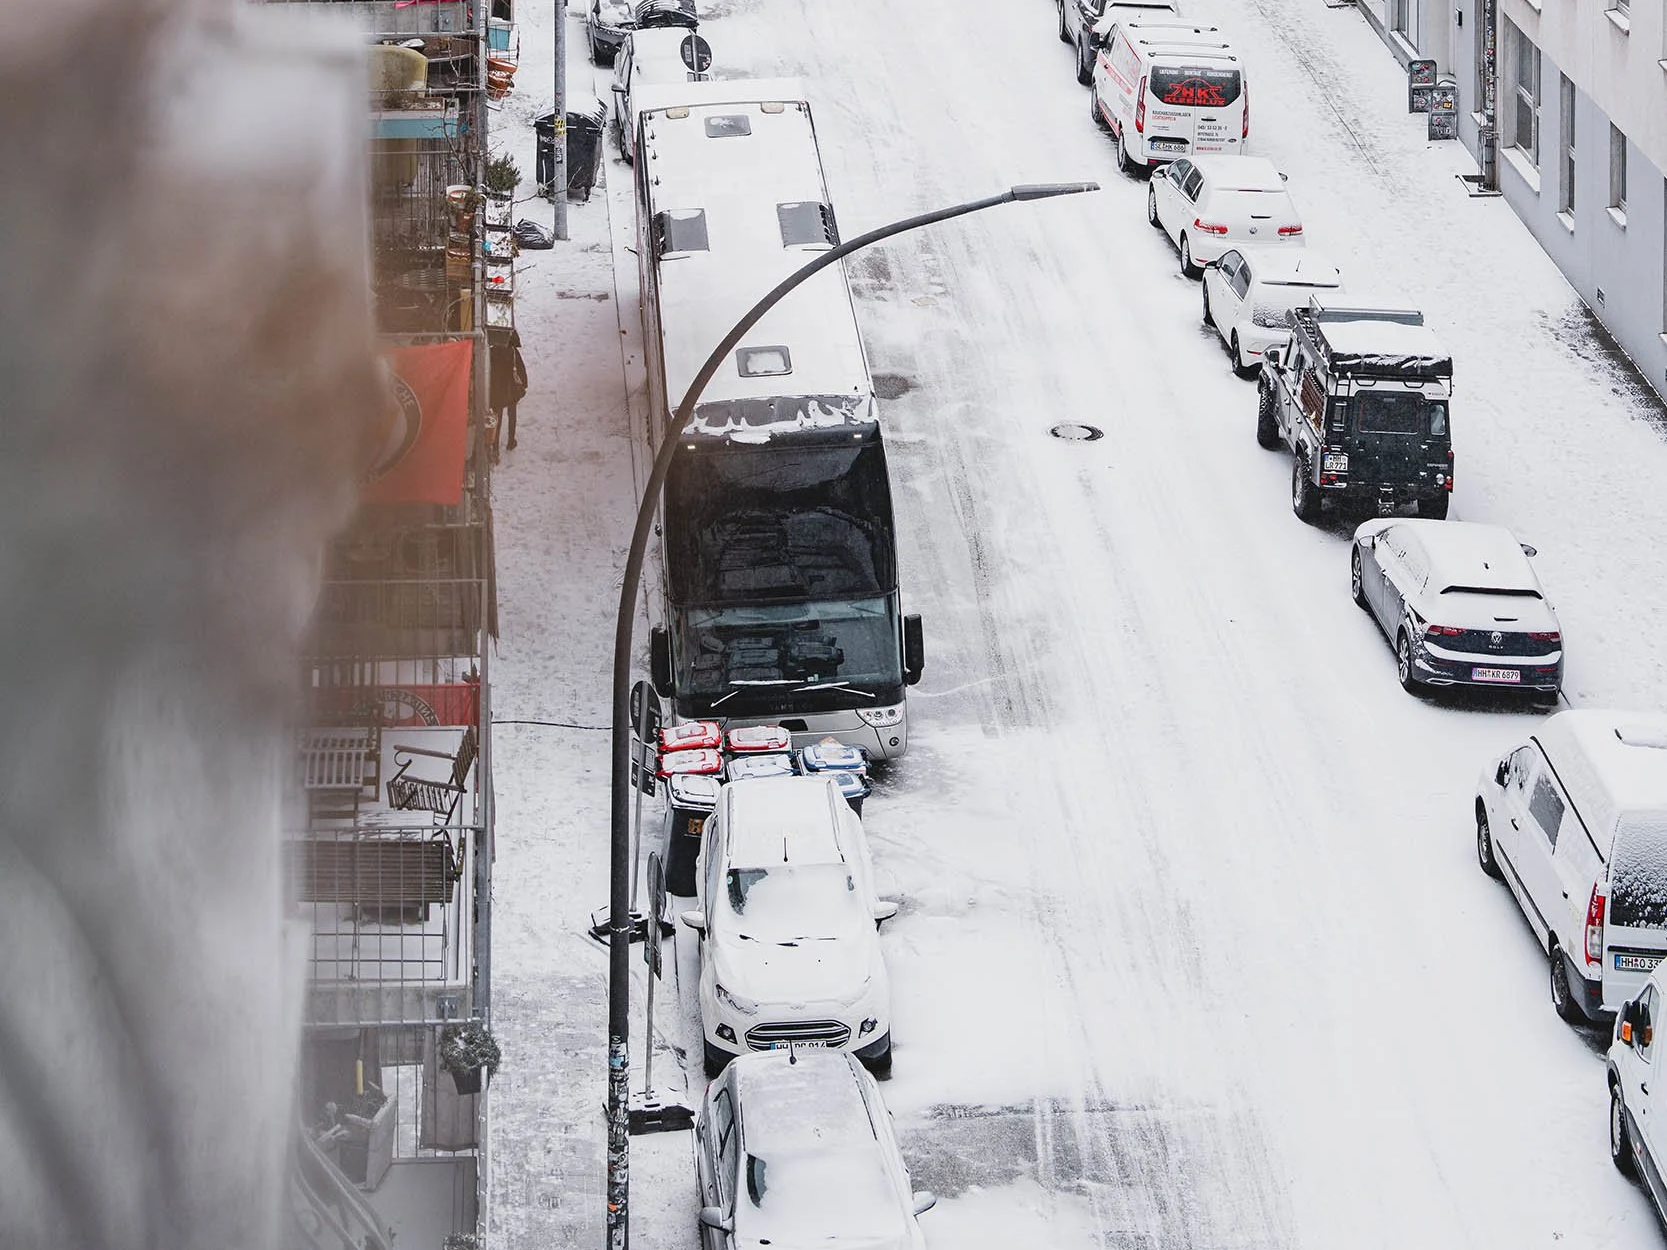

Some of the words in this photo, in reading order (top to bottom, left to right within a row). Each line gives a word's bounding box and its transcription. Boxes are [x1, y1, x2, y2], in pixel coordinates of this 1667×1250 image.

[1163, 96, 1225, 106] KLEENLUX
[1477, 669, 1487, 678] HH
[1621, 957, 1633, 967] HH
